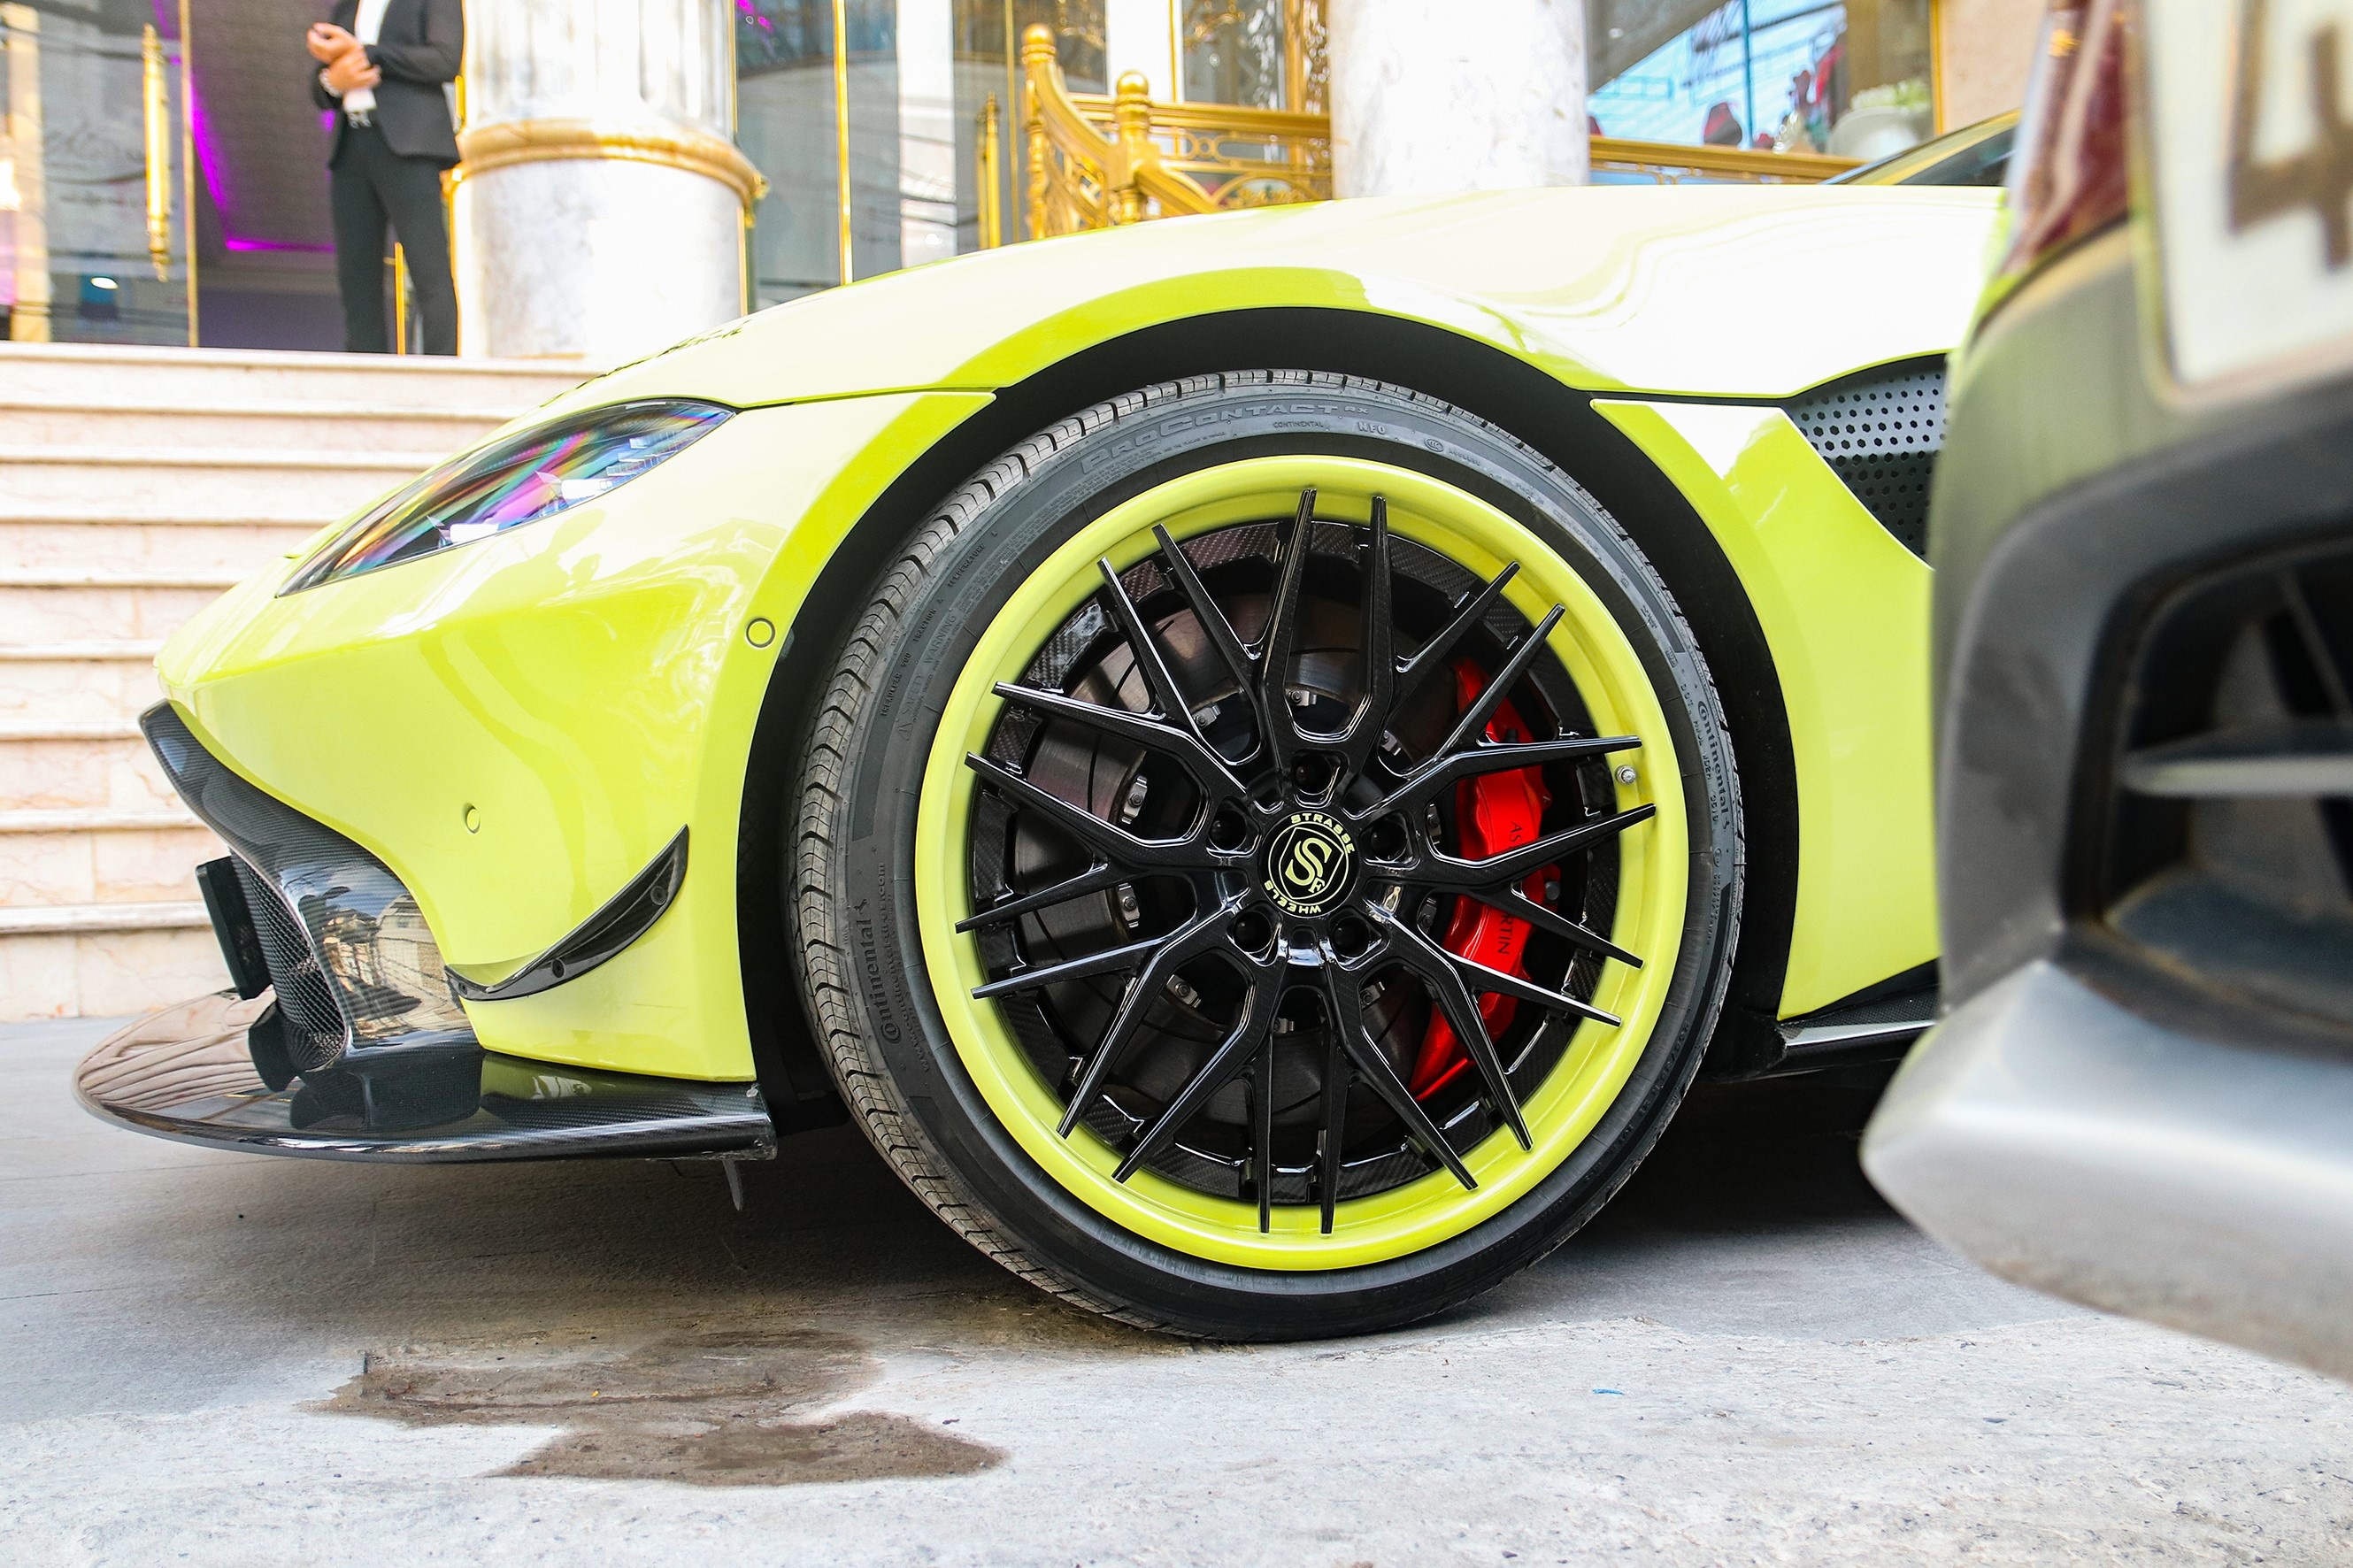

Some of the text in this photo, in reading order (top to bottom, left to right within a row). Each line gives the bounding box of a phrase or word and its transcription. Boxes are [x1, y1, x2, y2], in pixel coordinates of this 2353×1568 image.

[1273, 419, 1323, 428] CONTINENTAL
[948, 543, 985, 588] TEMPERATURE
[903, 613, 956, 717] SAFETY WARNING
[1680, 683, 1693, 706] DOT
[1697, 700, 1729, 812] Continental
[1291, 812, 1356, 854] STRASSE
[1264, 880, 1322, 915] WHEELS
[1496, 913, 1513, 955] RTIN
[856, 918, 902, 1044] Continental
